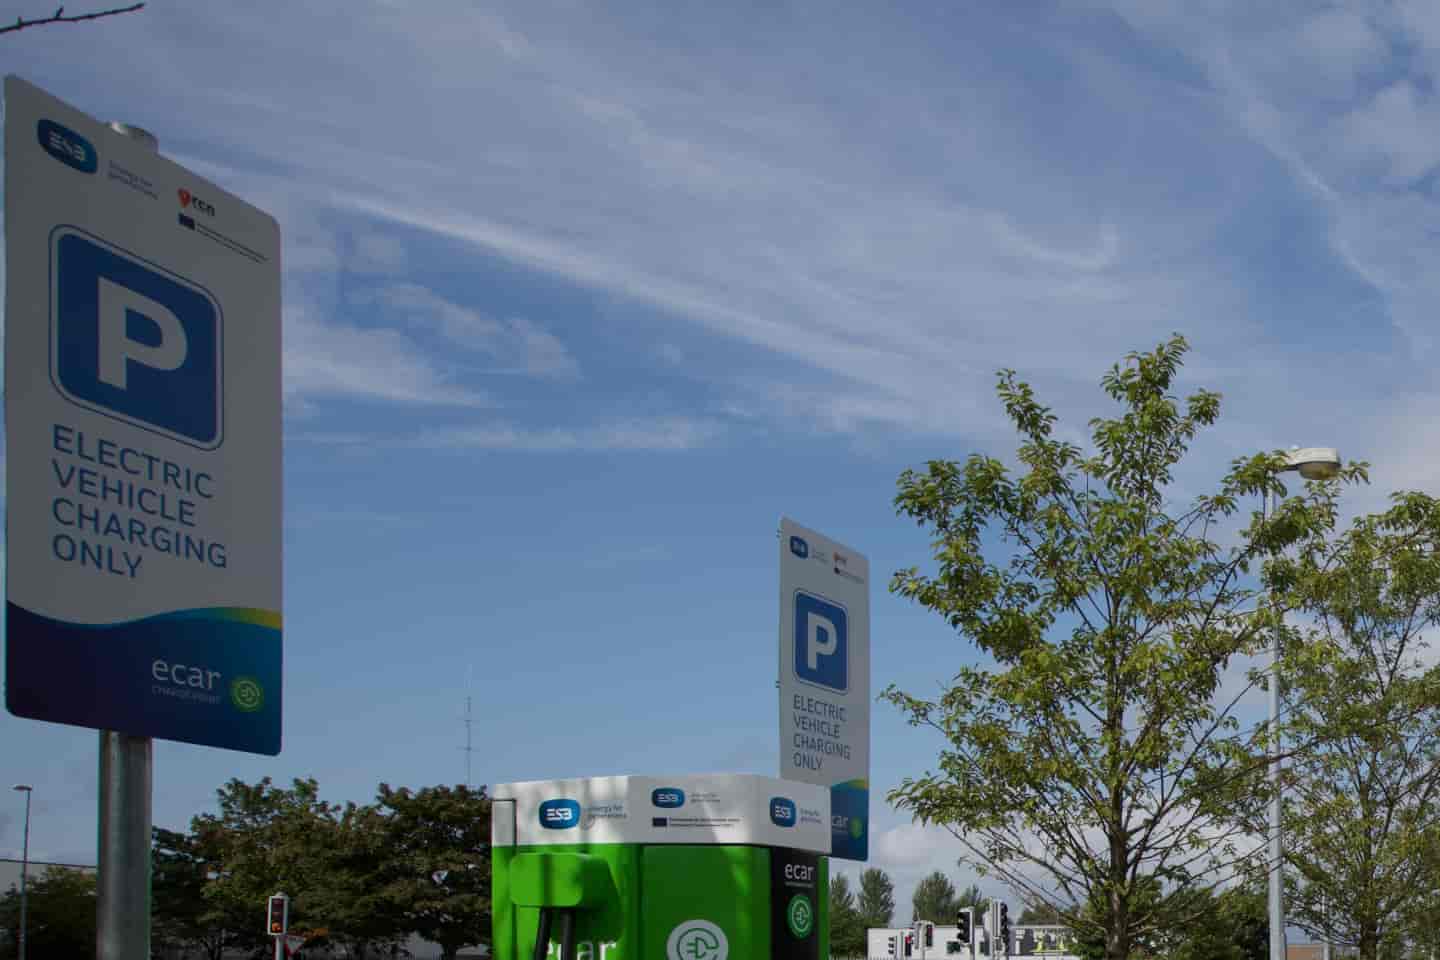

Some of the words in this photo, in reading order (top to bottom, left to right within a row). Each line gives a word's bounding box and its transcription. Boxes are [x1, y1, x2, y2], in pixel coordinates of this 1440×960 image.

[97, 275, 188, 391] P
[53, 423, 214, 499] ELECTRIC
[51, 457, 197, 528] VEHICLE
[52, 497, 227, 569] CHARGING
[52, 533, 143, 578] ONLY
[807, 611, 838, 669] P
[151, 658, 223, 689] ecar
[793, 694, 848, 721] ELECTRIC
[793, 712, 841, 739] VEHICLE
[793, 732, 851, 761] CHARGING
[793, 751, 824, 770] ONLY
[657, 793, 679, 803] ESB
[774, 804, 791, 818] ESB
[545, 807, 573, 821] ESB
[784, 863, 816, 881] ecar
